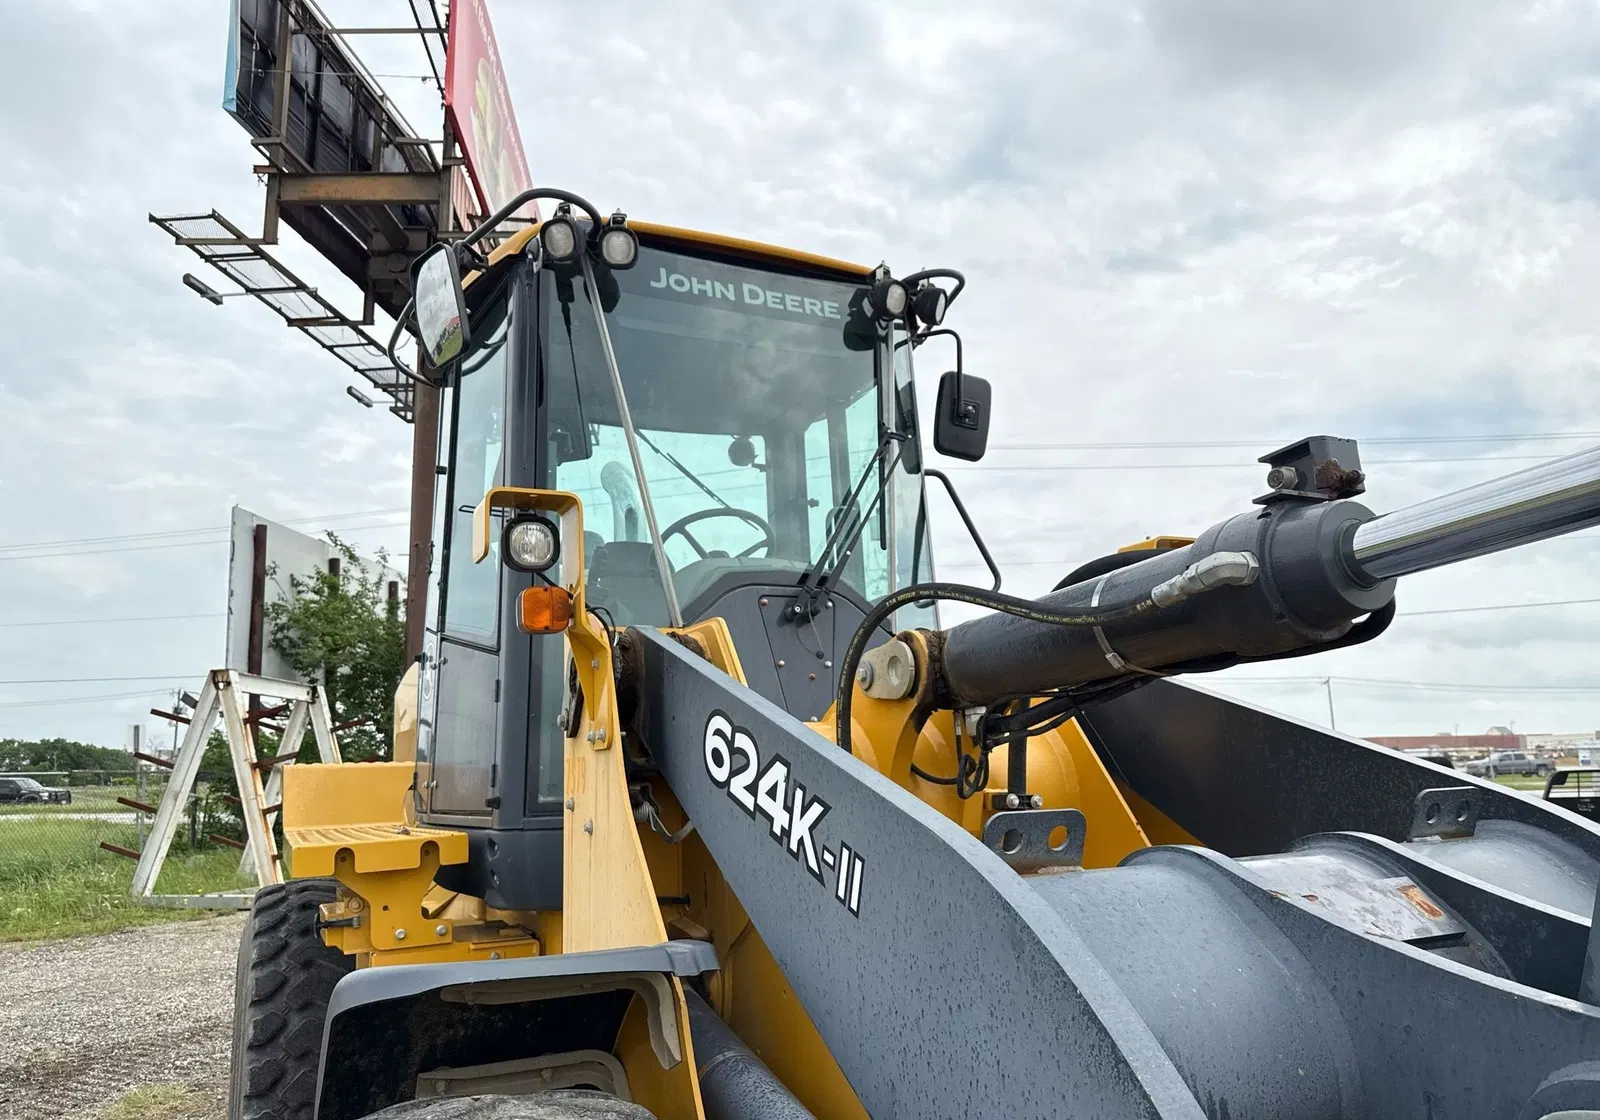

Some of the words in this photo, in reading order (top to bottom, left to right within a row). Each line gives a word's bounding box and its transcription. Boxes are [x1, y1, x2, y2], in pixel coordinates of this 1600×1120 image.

[650, 267, 736, 301] JOHN
[742, 282, 842, 319] DEERE
[704, 711, 864, 917] 624K-II
